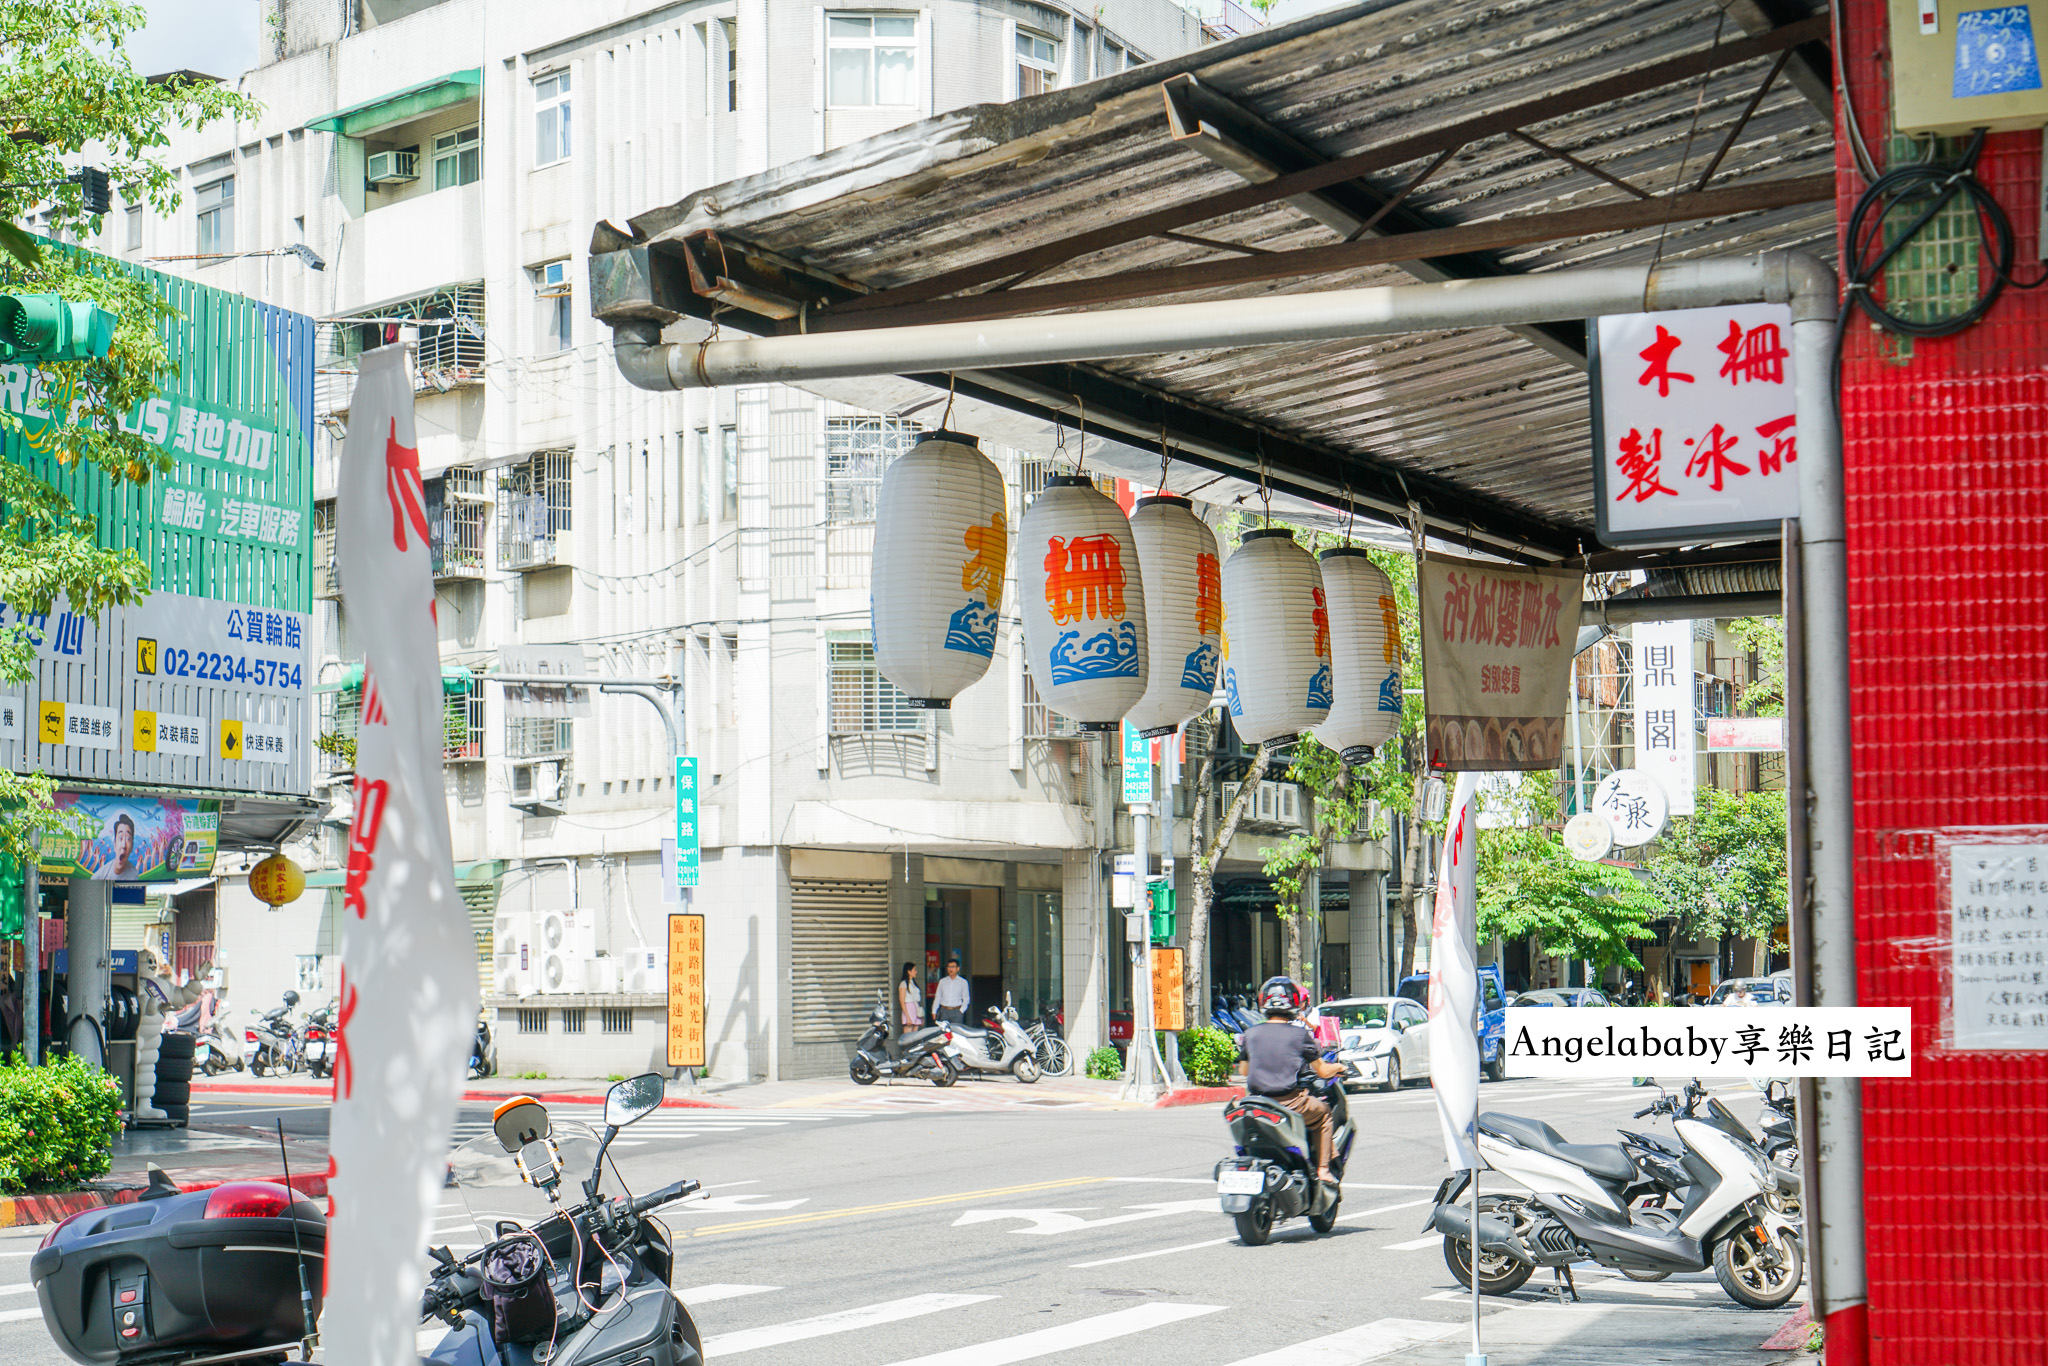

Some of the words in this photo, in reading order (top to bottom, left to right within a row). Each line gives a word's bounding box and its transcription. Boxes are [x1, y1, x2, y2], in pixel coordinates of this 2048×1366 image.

[1638, 320, 1790, 398] 木柵
[172, 406, 273, 471] 馳加
[227, 609, 301, 649] 公賀輪胎
[164, 647, 302, 690] 02-2234-5754
[1642, 622, 1677, 750] 鼎閣
[3, 708, 14, 728] 機
[68, 716, 112, 738] 底盤維修
[159, 724, 200, 745] 改裝精品
[245, 733, 284, 753] 快速保養
[680, 775, 694, 837] 保儀路
[672, 919, 684, 1060] 施工請減速慢行
